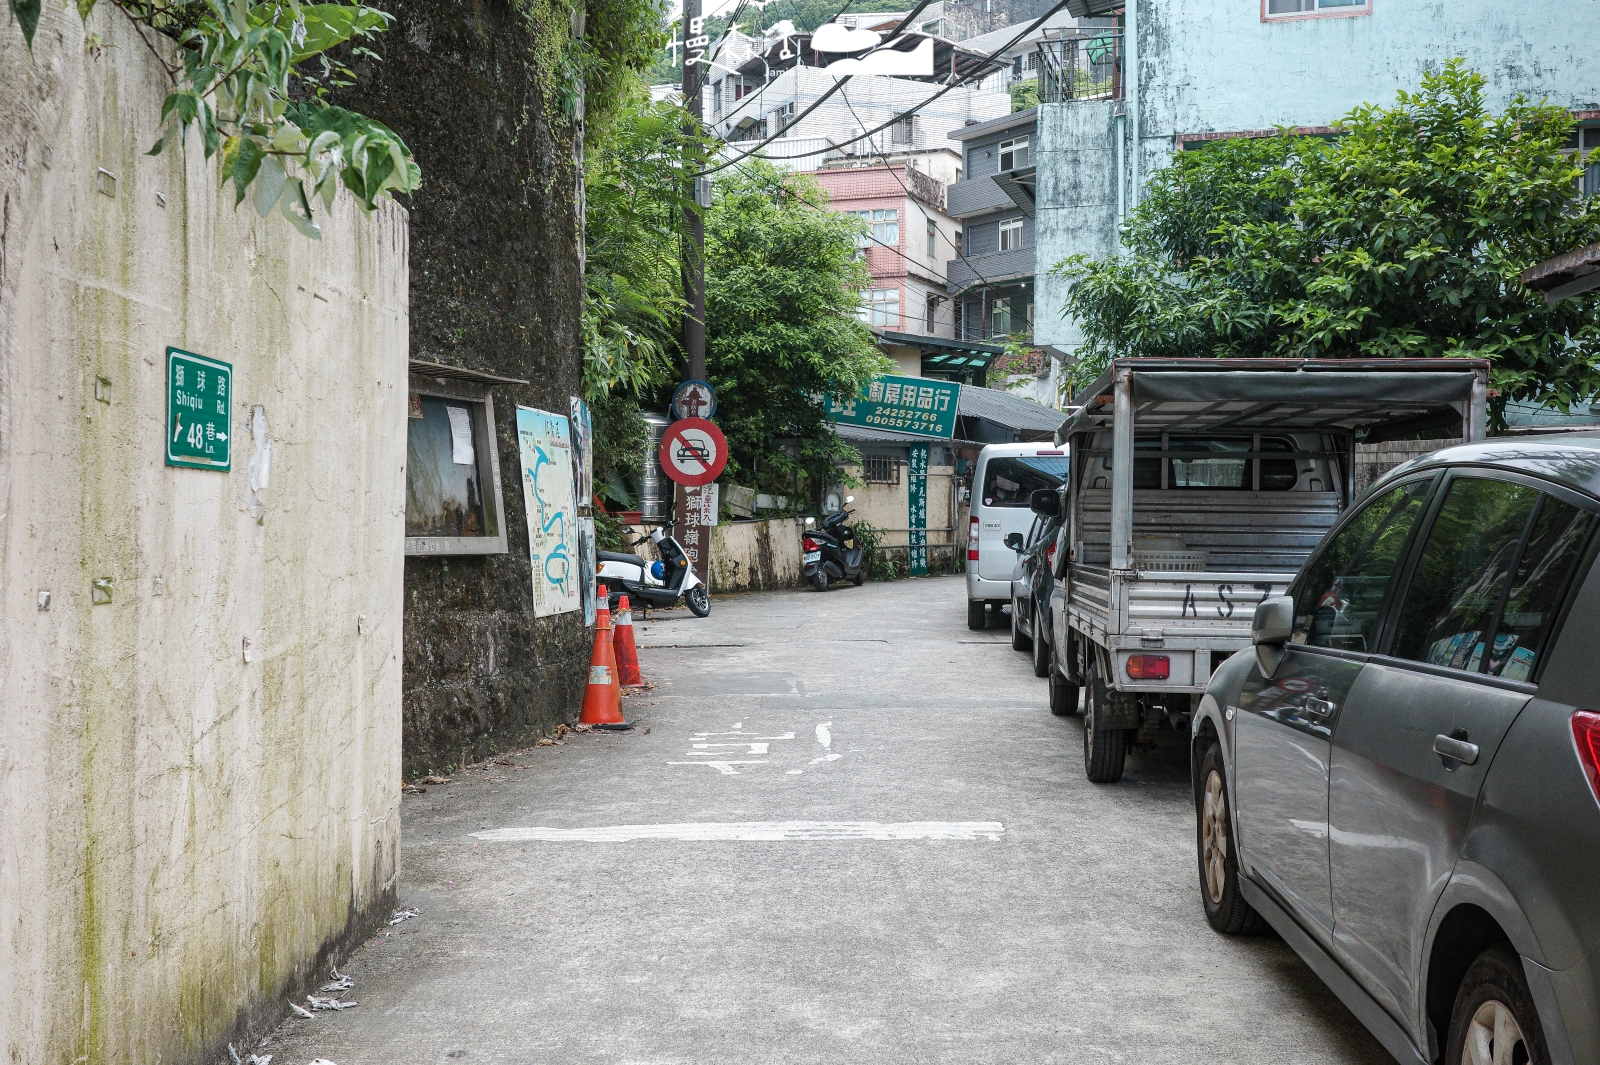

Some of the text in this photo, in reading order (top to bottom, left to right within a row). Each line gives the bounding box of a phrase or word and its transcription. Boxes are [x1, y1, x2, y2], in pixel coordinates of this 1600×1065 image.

[176, 389, 203, 412] Shiqiu
[875, 406, 938, 422] 24252766
[865, 415, 943, 433] 0905573716
